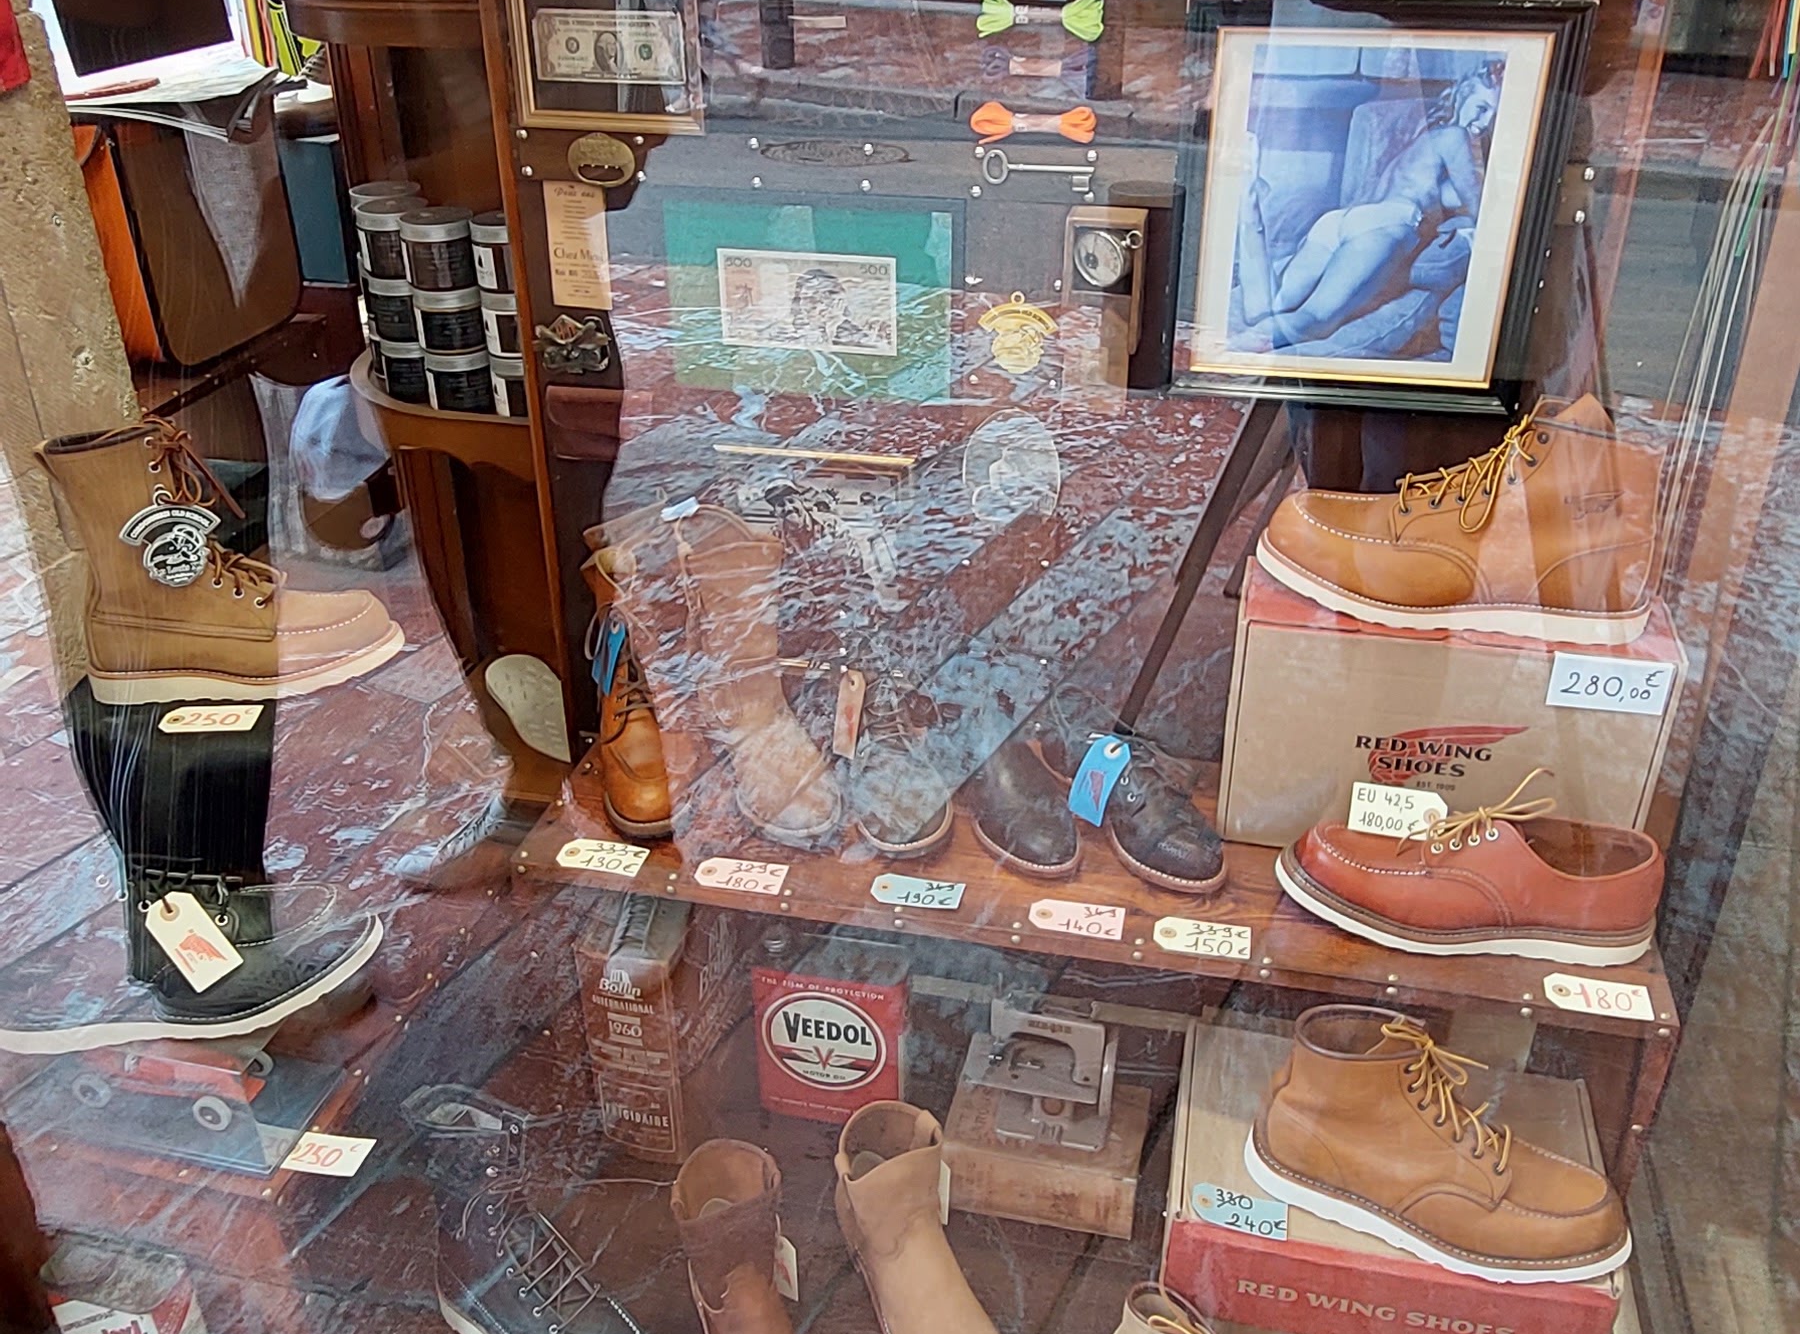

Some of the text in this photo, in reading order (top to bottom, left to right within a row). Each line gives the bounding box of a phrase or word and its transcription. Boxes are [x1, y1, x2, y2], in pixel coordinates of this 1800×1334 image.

[725, 257, 753, 268] 500
[1355, 735, 1493, 763] RED WING
[1377, 757, 1466, 778] SHOES
[1357, 787, 1415, 813] EU 42,5
[761, 976, 885, 1001] THE FILM OF PROTECTION
[609, 1019, 643, 1039] 1960
[782, 1010, 873, 1047] VEEDOL
[1236, 1279, 1300, 1305] RED
[1305, 1292, 1397, 1322] WING
